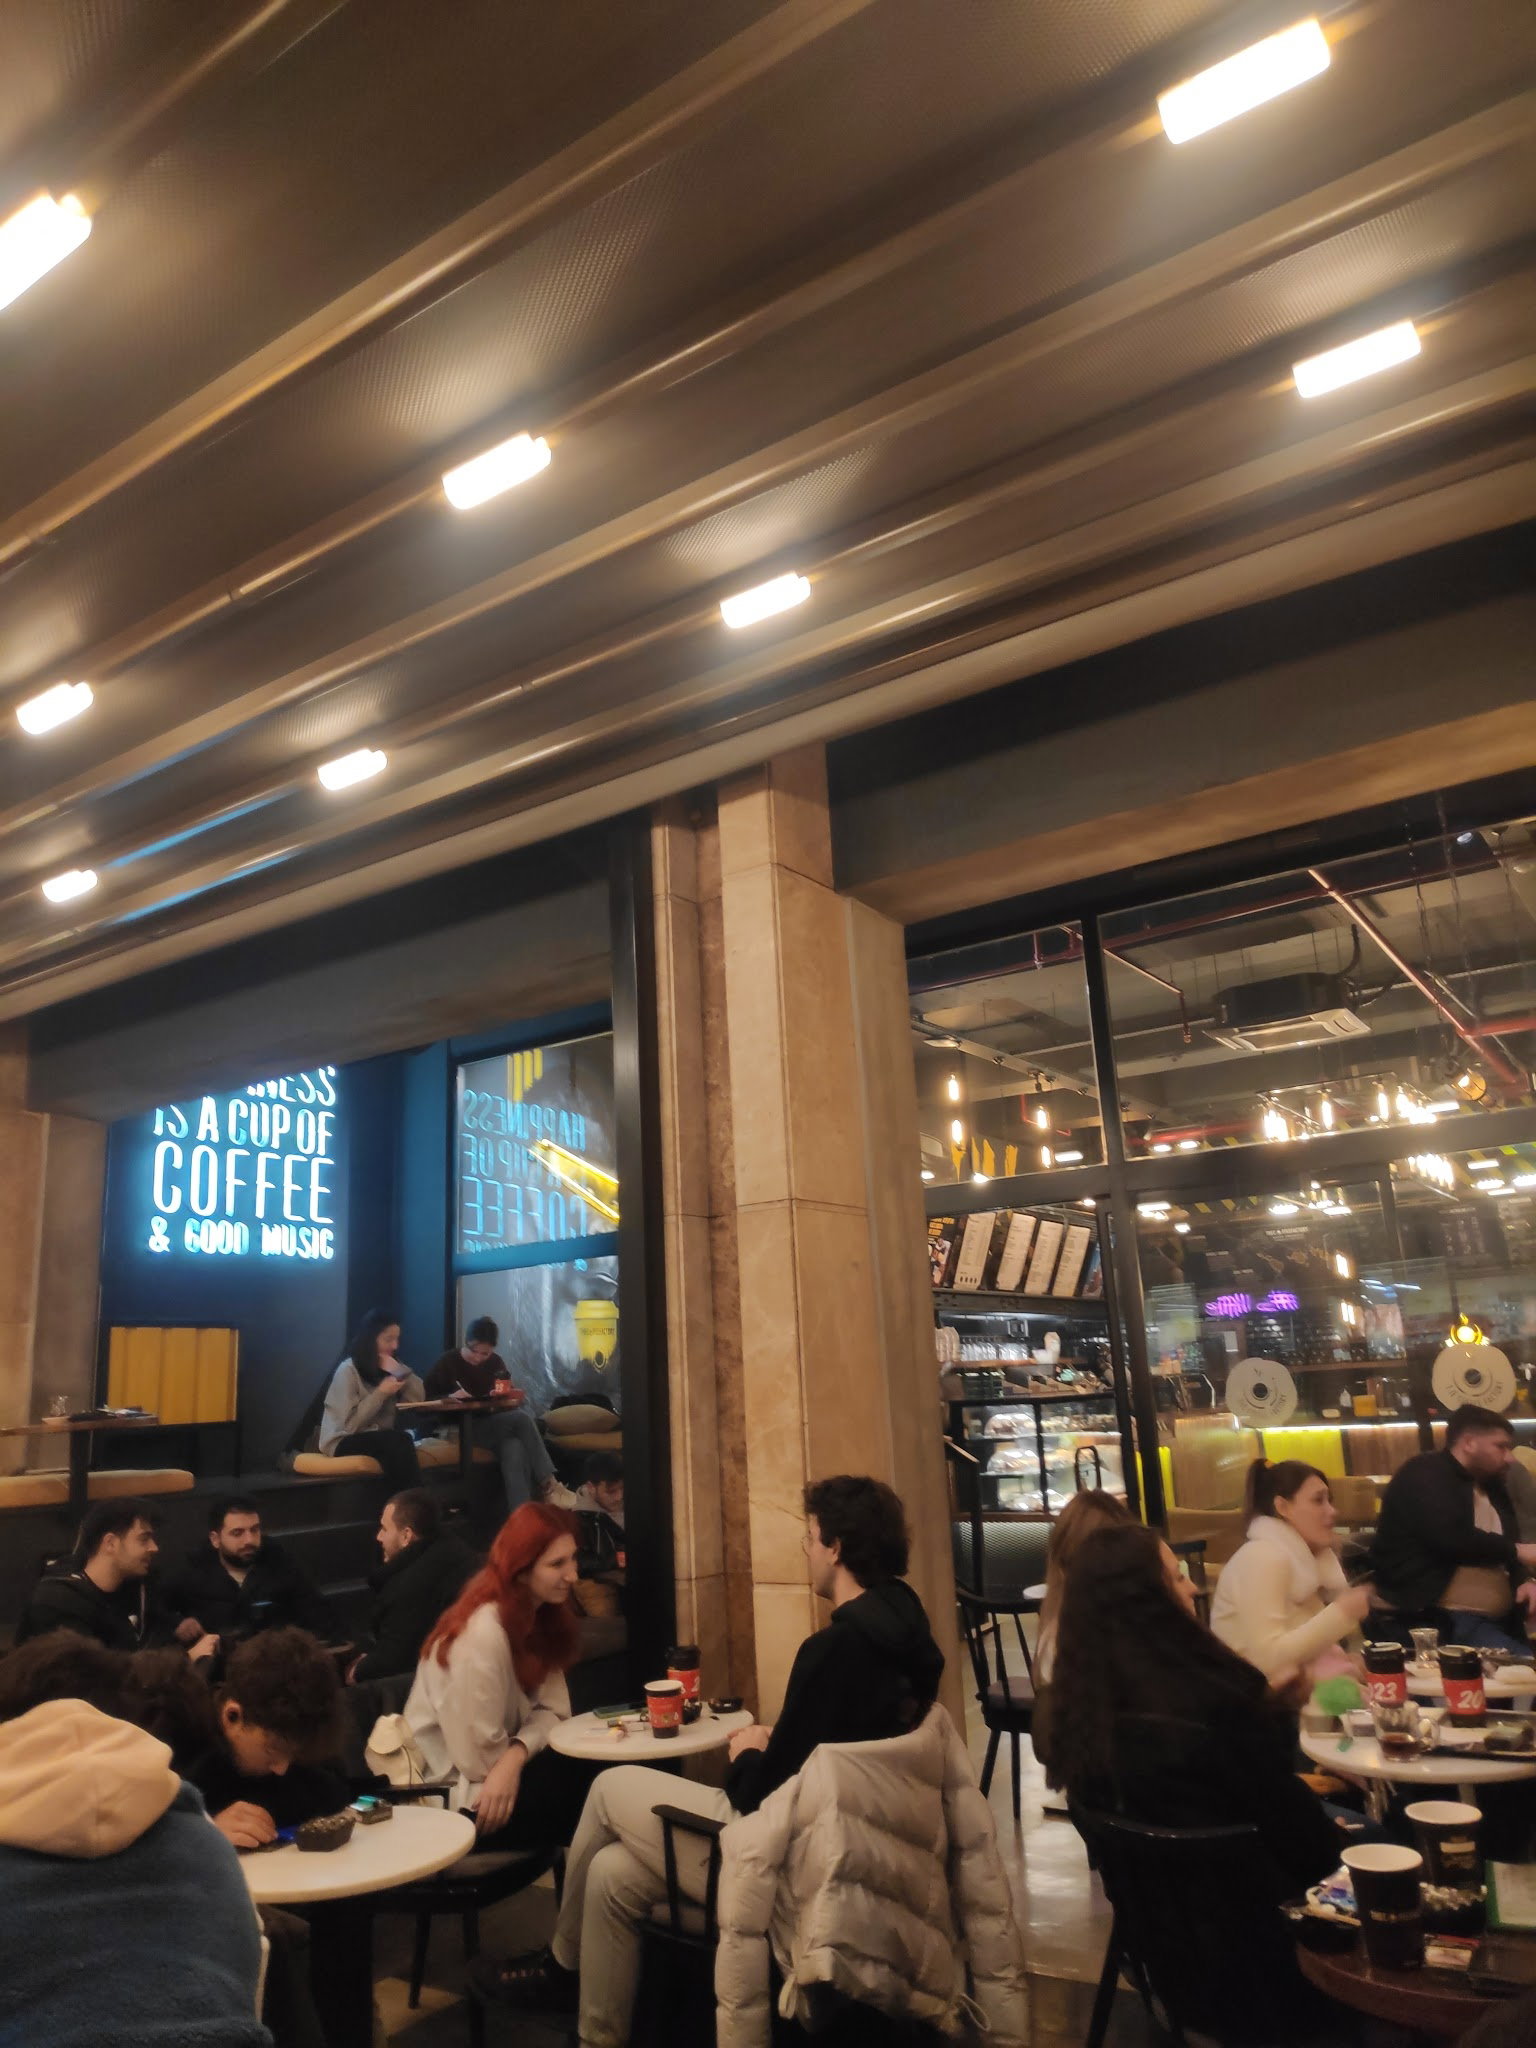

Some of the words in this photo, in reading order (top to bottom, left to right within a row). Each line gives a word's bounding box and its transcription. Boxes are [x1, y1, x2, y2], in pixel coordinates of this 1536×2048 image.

[153, 1104, 189, 1139] IS
[196, 1095, 219, 1143] A
[228, 1098, 291, 1149] CUP
[296, 1109, 336, 1156] OF
[153, 1140, 336, 1224] COFFEE
[148, 1215, 171, 1253] &
[184, 1217, 250, 1256] GOOD
[260, 1222, 335, 1260] MUSIC
